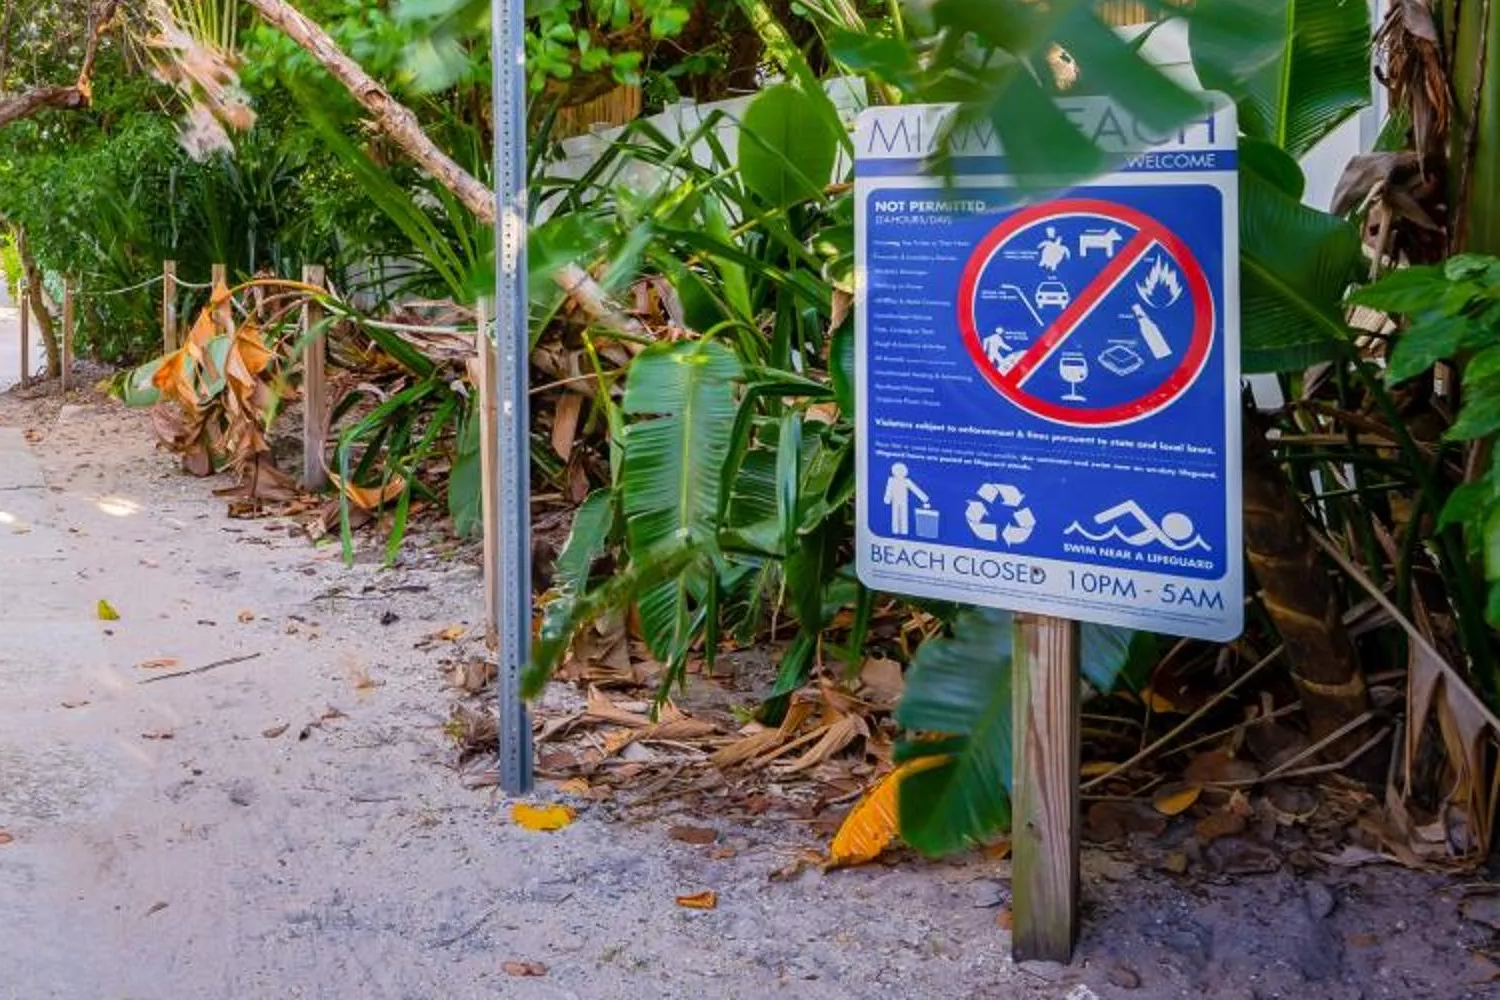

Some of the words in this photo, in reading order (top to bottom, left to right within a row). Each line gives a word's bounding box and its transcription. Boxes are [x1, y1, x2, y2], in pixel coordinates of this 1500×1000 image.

[1124, 152, 1217, 169] WELCOME
[874, 200, 905, 213] NOT
[908, 200, 987, 213] PERMITTED
[1062, 542, 1098, 557] SWIM
[1099, 547, 1132, 561] NEAR
[1135, 551, 1145, 562] A
[1147, 554, 1215, 570] LIFEGUARD
[870, 542, 946, 572] BEACH
[953, 554, 1047, 585] CLOSED
[1068, 569, 1138, 600] 10PM
[1160, 583, 1225, 612] 5AM
